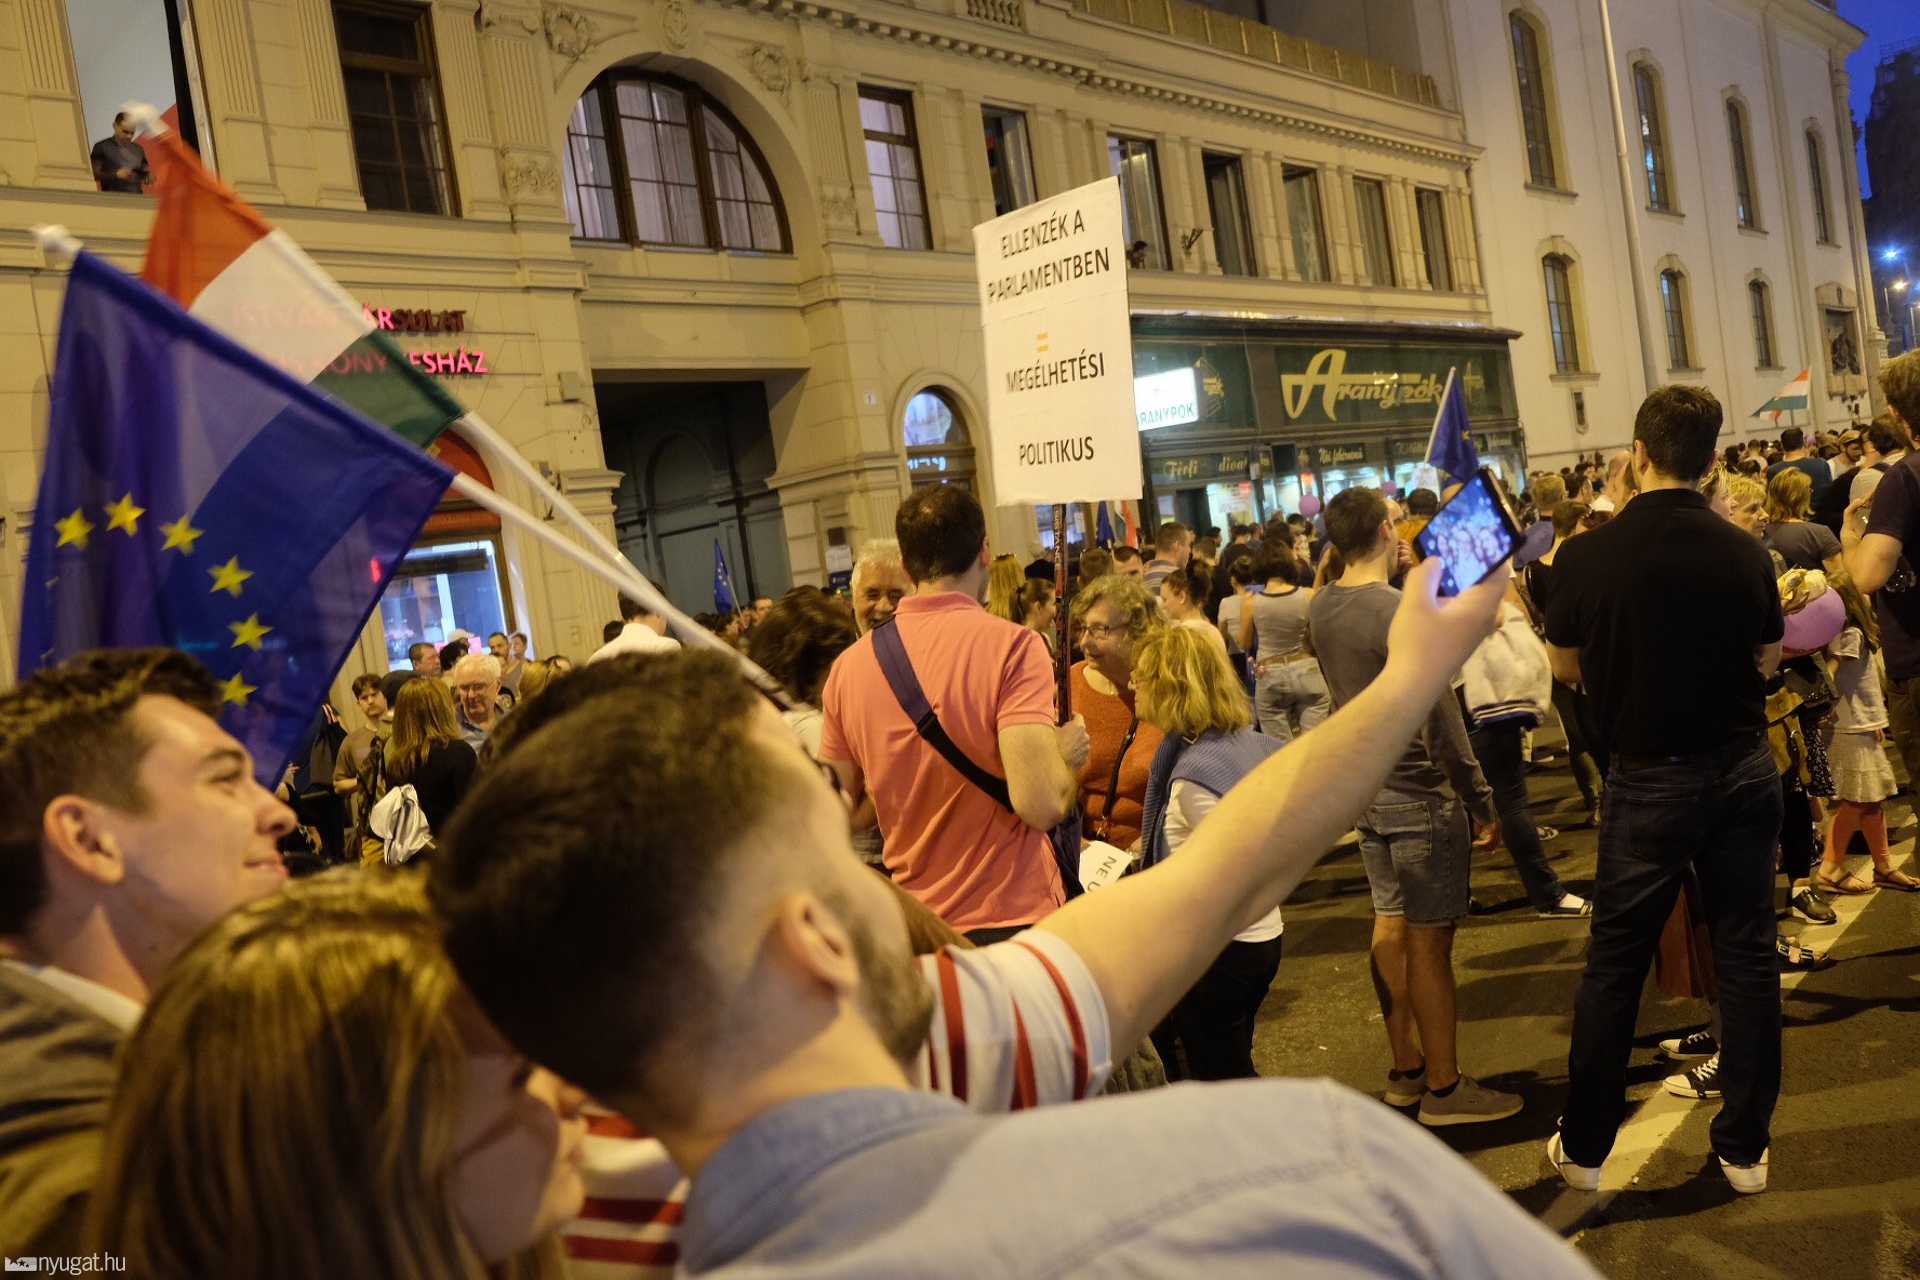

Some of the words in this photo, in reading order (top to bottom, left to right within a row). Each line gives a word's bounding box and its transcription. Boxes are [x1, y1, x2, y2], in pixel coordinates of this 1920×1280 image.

[1001, 210, 1069, 258] ELLENZÉK
[1072, 209, 1085, 233] A
[987, 247, 1110, 304] PARLAMENTBEN
[1005, 348, 1105, 394] MEGÉLHETÉSI
[1019, 436, 1095, 466] POLITIKUS
